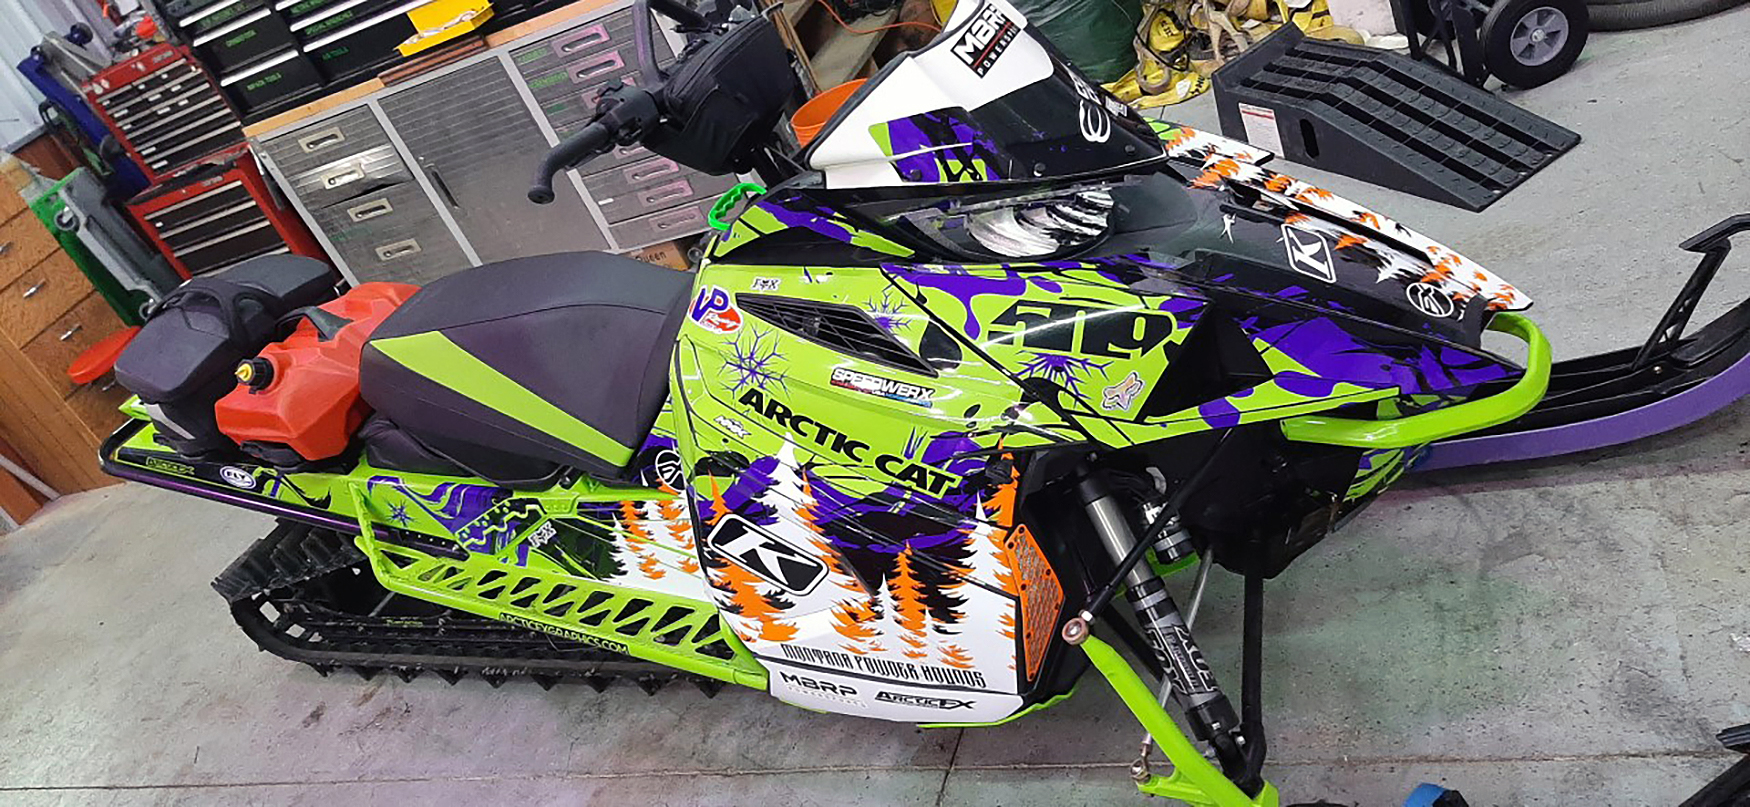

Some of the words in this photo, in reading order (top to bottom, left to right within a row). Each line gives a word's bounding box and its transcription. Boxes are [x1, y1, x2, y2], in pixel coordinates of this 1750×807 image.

[953, 5, 1006, 65] MBRP
[832, 368, 934, 400] SPEEDWERX
[739, 388, 870, 462] ARCTIC
[875, 454, 956, 495] CAT
[780, 643, 854, 670] MONTANA
[854, 655, 920, 681] POWDER
[921, 665, 987, 688] HOUNDS
[780, 671, 858, 697] MBRP
